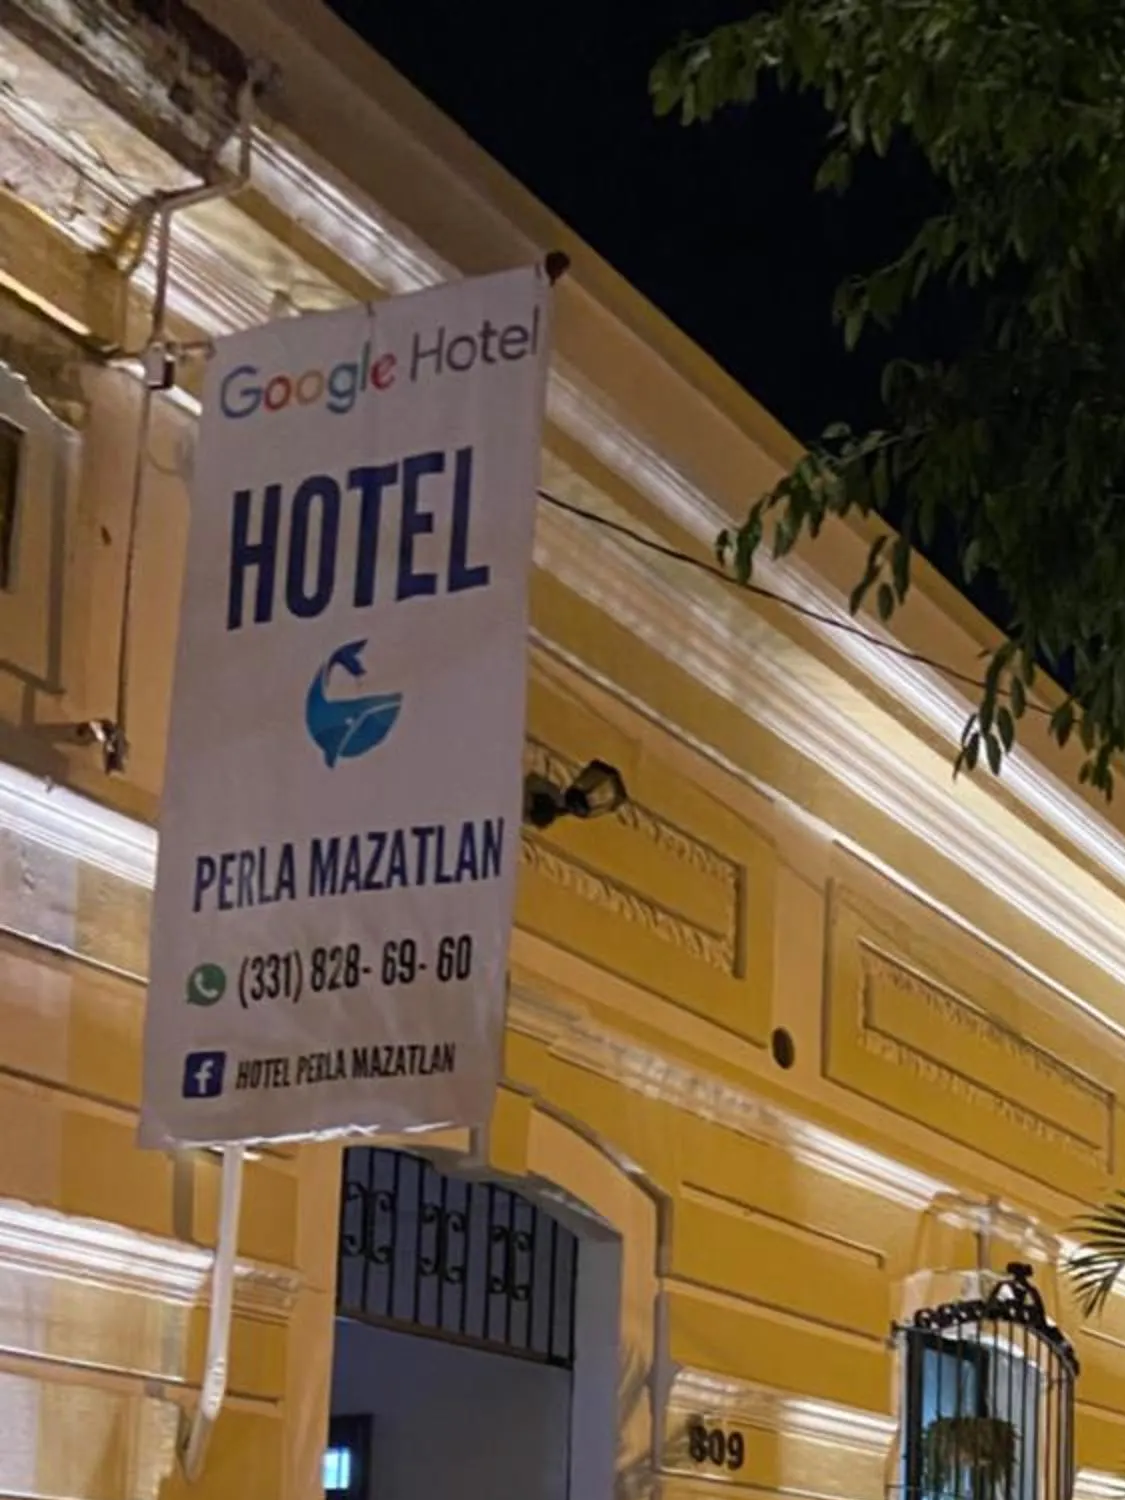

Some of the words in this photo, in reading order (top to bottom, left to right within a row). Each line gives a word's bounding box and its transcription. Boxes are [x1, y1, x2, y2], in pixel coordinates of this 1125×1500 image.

[219, 340, 397, 418] Google
[410, 305, 540, 381] Hotel
[227, 446, 490, 630] HOTEL
[193, 842, 297, 912] PERLA
[308, 817, 505, 897] MAZATLAN
[238, 949, 303, 1009] (331)
[235, 1057, 290, 1090] HOTEL
[296, 1049, 347, 1086] PERLA
[352, 1043, 456, 1078] MAZATLAN
